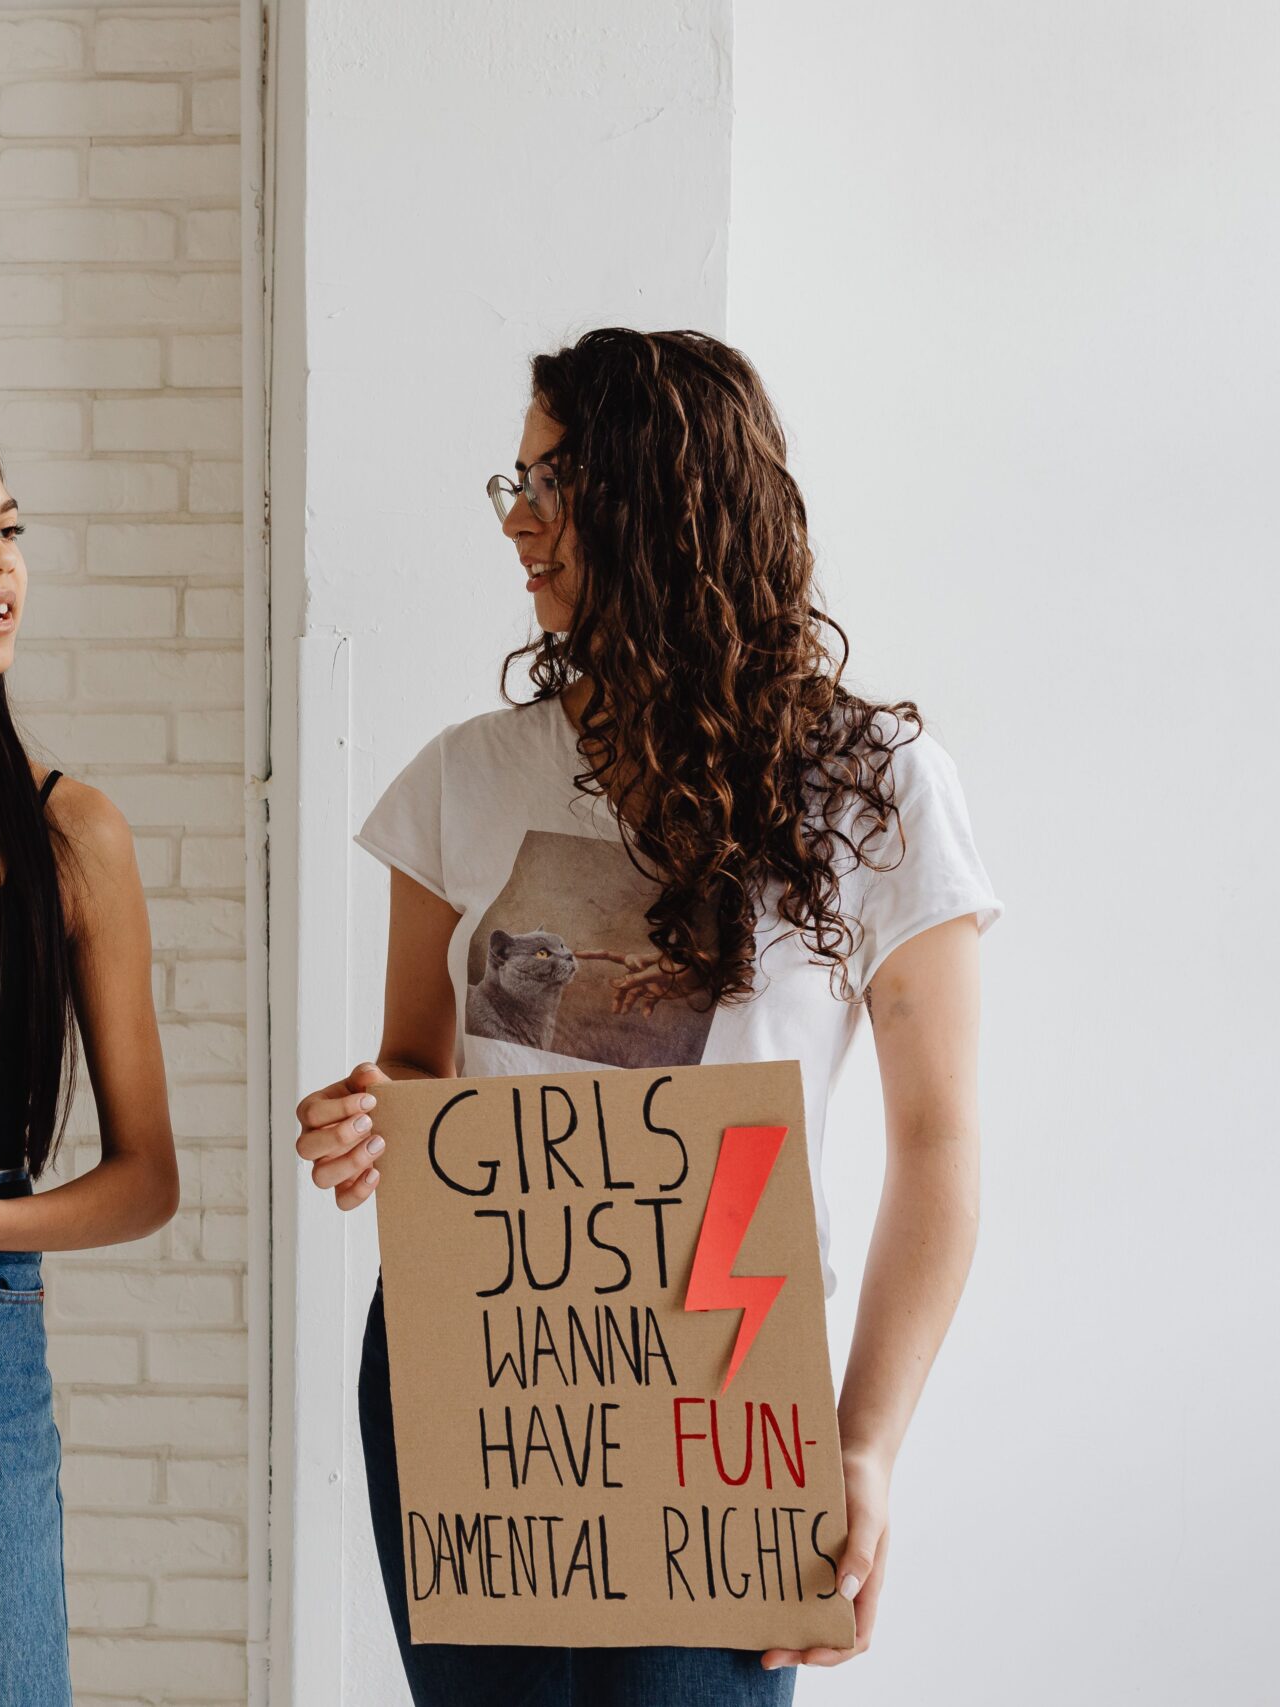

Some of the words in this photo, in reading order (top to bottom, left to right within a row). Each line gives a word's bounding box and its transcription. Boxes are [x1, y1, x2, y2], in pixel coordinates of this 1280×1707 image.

[427, 1075, 690, 1197] GIRLS
[474, 1197, 682, 1298] JUST
[482, 1304, 677, 1389] WANNA
[478, 1402, 623, 1490] HAVE
[673, 1396, 817, 1490] FUN-
[407, 1510, 628, 1602] DAMENTAL
[662, 1504, 838, 1603] RIGHTS
